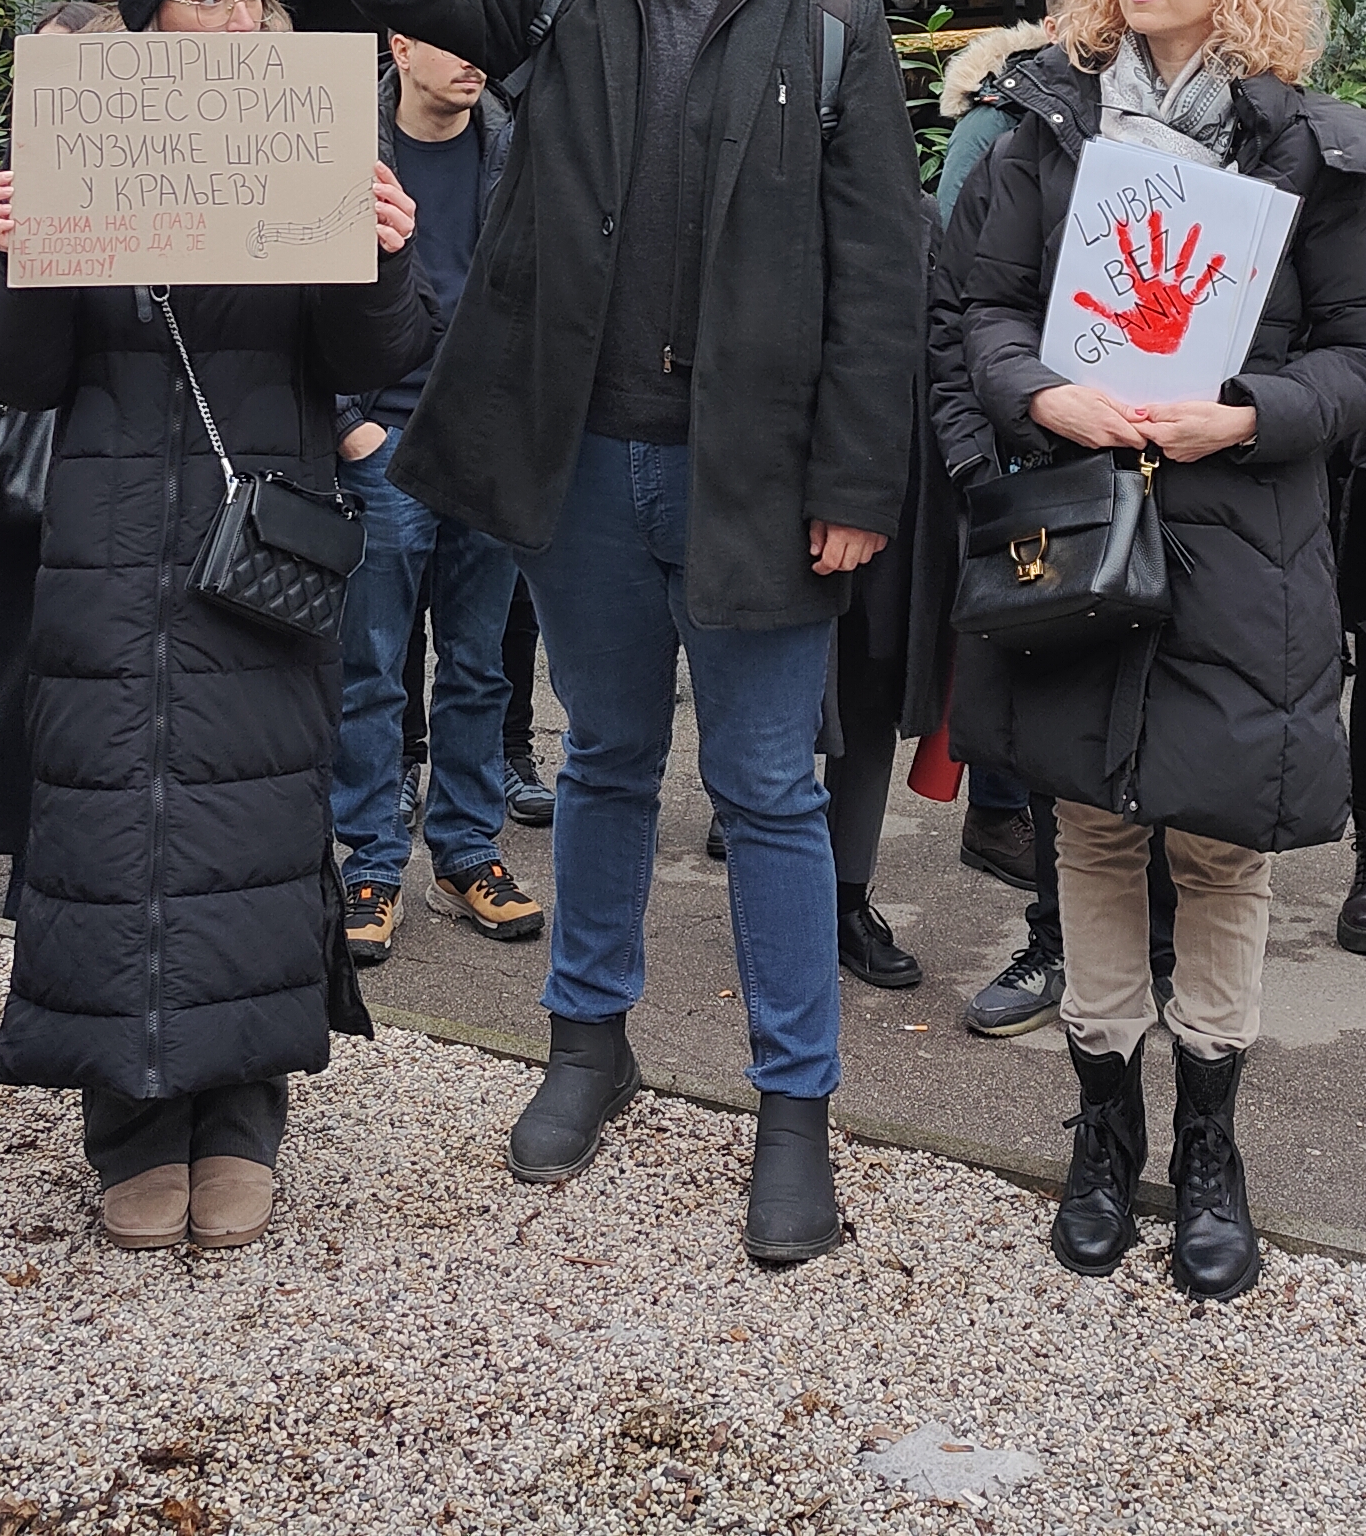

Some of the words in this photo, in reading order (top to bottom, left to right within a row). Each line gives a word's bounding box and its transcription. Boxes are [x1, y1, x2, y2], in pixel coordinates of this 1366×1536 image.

[78, 38, 284, 85] ПОДРШКА
[34, 86, 335, 128] ПРОФЕСОРИМА
[57, 133, 207, 170] МУЗИЧКЕ
[225, 130, 335, 166] ШКОЛЕ
[80, 176, 94, 209] У
[115, 172, 269, 212] КРАЉЕВУ
[1073, 164, 1186, 247] LJUBAV
[12, 237, 33, 256] НЕ
[38, 234, 141, 255] ДОЗВОЛИМО
[147, 233, 174, 253] ДА
[186, 233, 206, 251] ЈЕ
[13, 215, 92, 236] МУЗИКА
[105, 213, 138, 232] НАС
[18, 254, 116, 279] УТИШАЈУ!
[1104, 229, 1184, 296] BEZ
[1074, 264, 1237, 364] GRANICA
